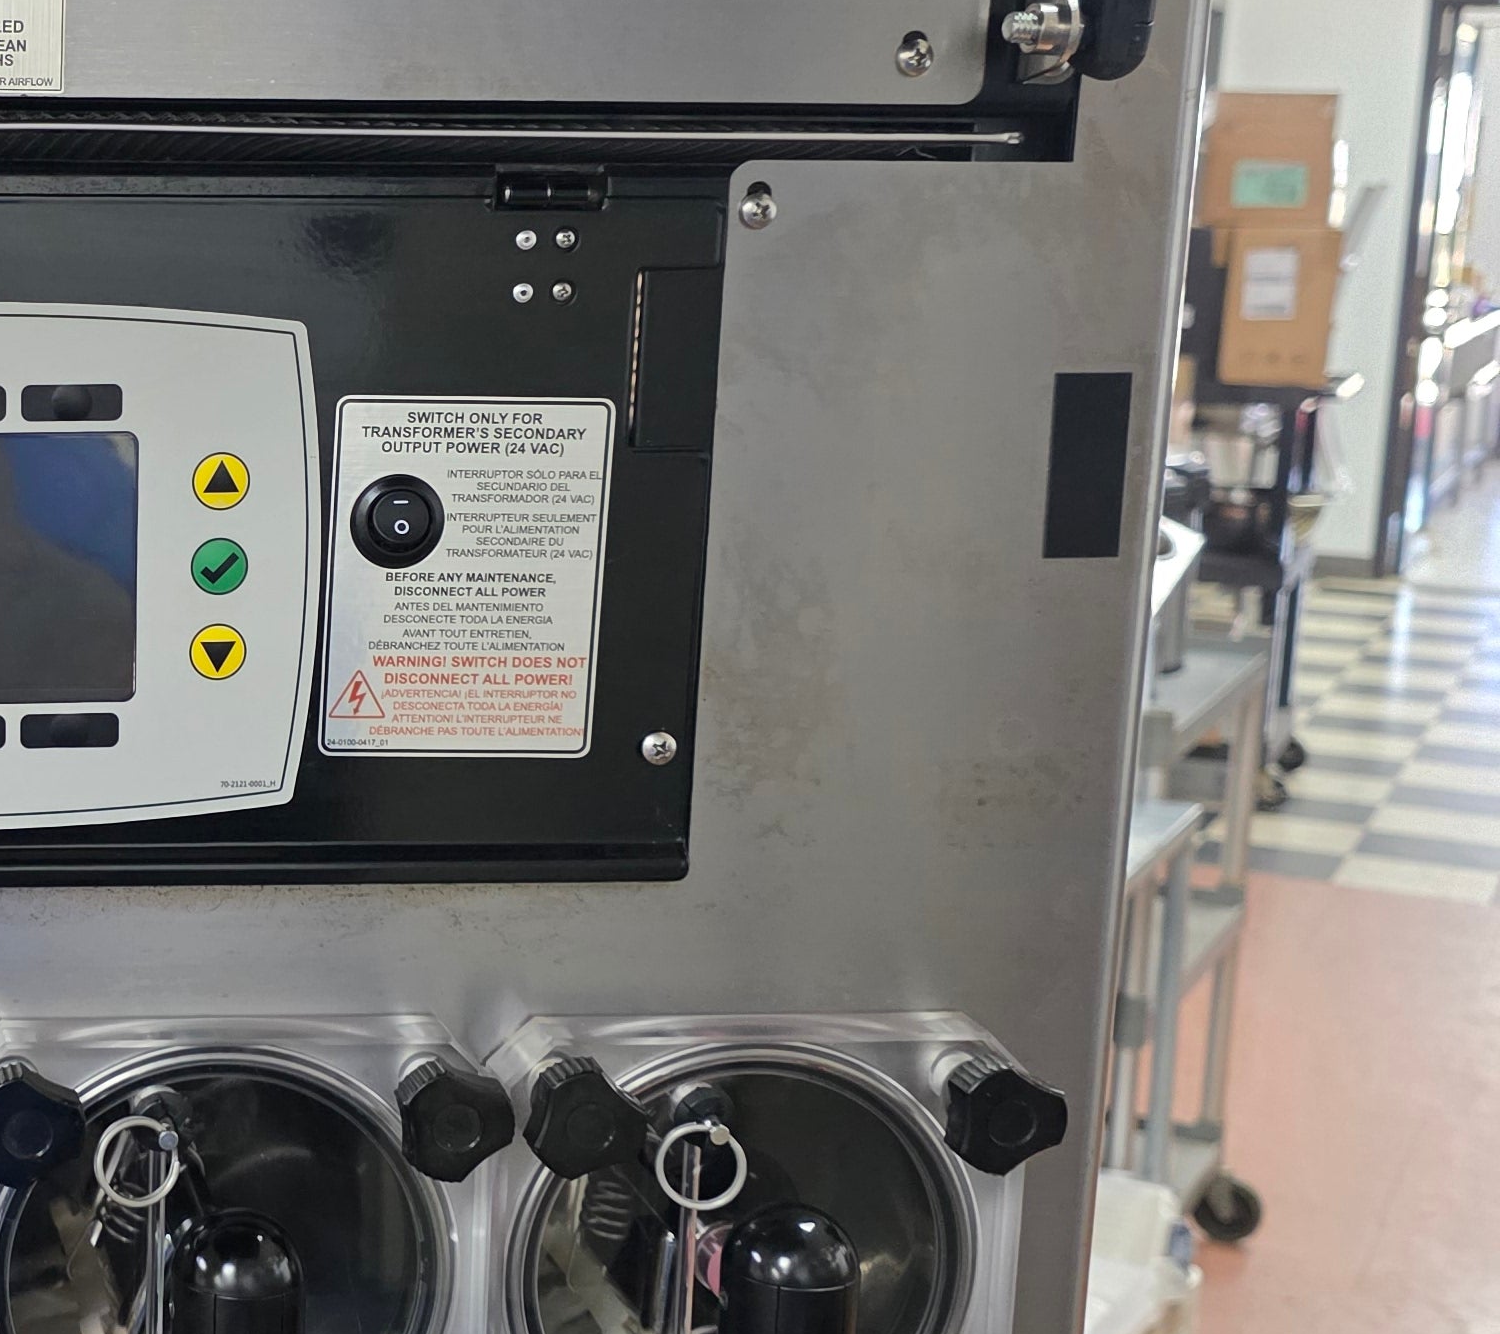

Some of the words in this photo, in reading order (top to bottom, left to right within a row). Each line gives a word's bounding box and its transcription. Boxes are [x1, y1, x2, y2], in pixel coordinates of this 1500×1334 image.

[7, 77, 54, 86] AIRFLOW
[406, 411, 464, 424] SWITCH
[468, 412, 508, 424] ONLY
[512, 412, 543, 425] FOR
[361, 425, 489, 439] TRANSFORMER'S
[492, 427, 586, 440] SECONDARY
[381, 440, 442, 453] OUTPUT
[445, 441, 500, 454] POWER
[504, 441, 526, 457] (24
[529, 442, 564, 457] VAC)
[385, 571, 434, 582] BEFORE
[437, 572, 463, 582] ANY
[465, 572, 555, 583] MAINTENANCE,
[393, 585, 473, 596] DISCONNECT
[474, 586, 498, 597] ALL
[501, 587, 546, 597] POWER
[372, 655, 446, 667] WARNING!
[450, 655, 507, 668] SWITCH
[511, 656, 552, 668] DOES
[557, 656, 587, 668] NOT
[383, 672, 479, 685] DISCONNECT
[481, 673, 510, 685] ALL
[514, 673, 572, 685] POWER!
